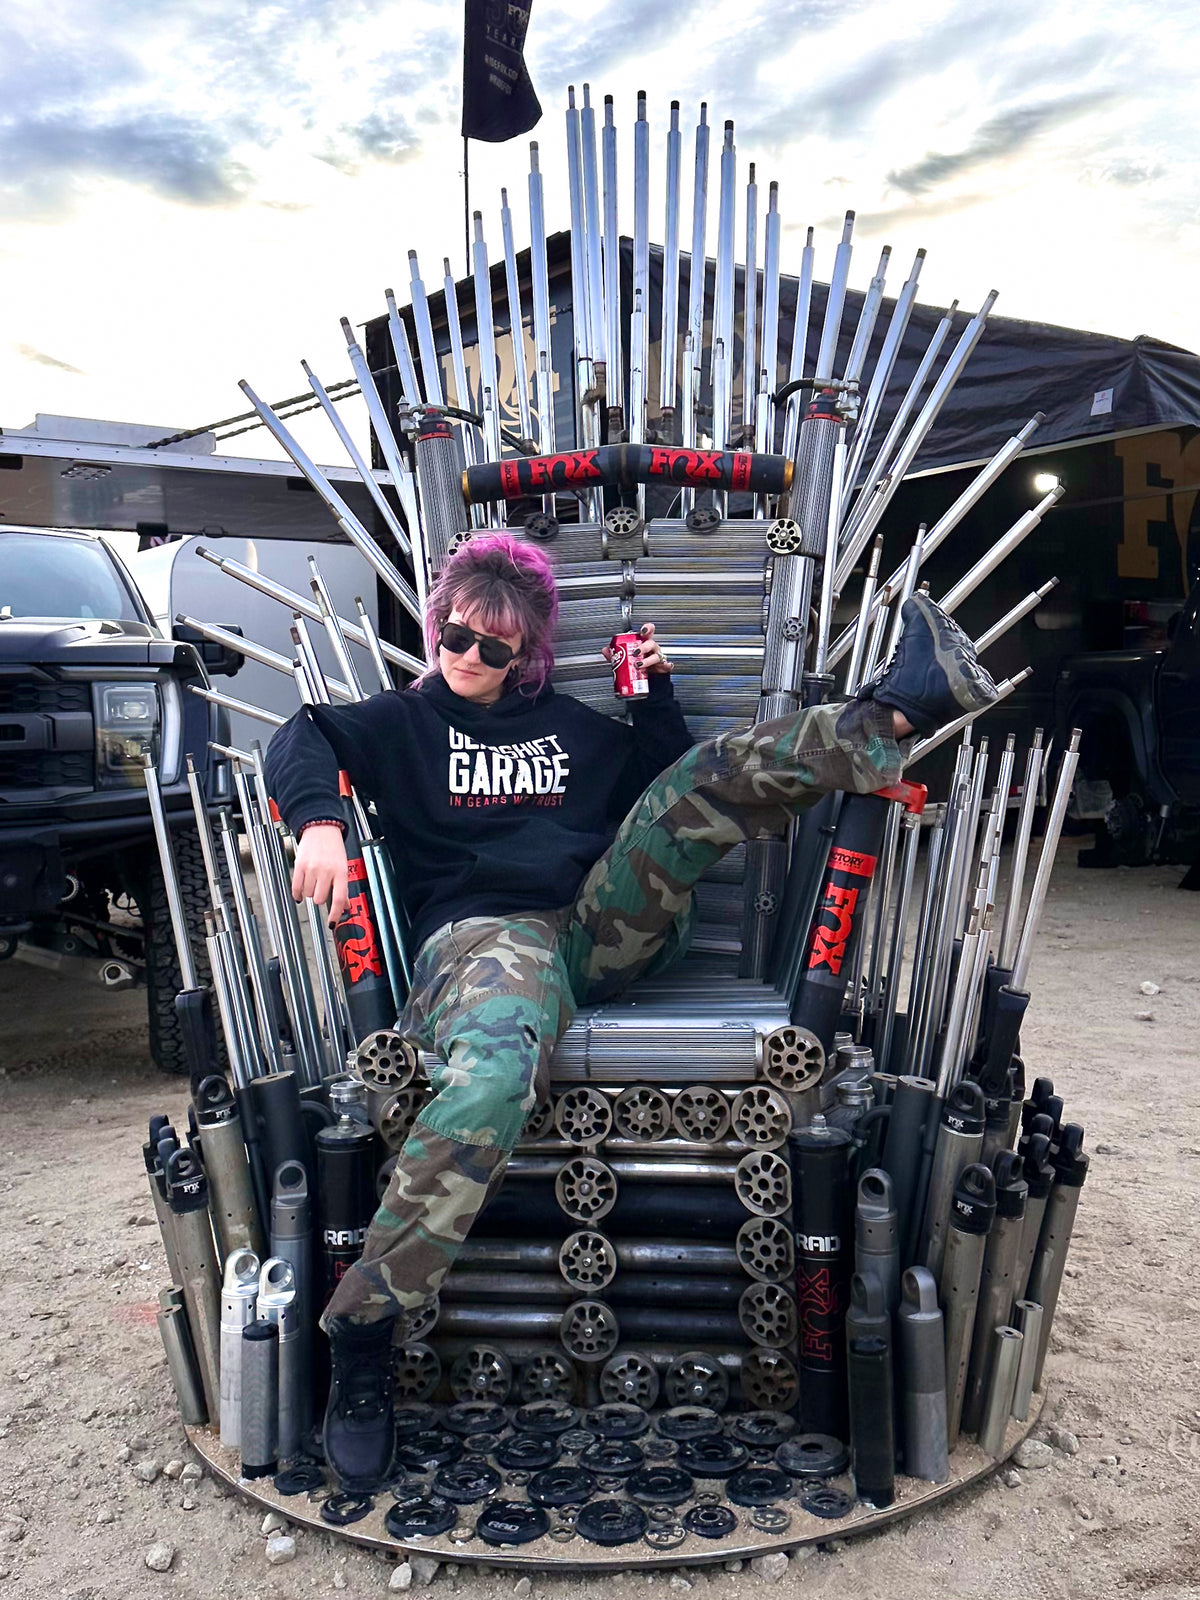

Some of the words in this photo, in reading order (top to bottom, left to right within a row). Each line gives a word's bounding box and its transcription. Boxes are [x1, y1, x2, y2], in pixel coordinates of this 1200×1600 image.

[528, 450, 601, 486] FOX
[649, 447, 723, 480] FOX
[449, 725, 563, 759] GESHIFT
[449, 751, 569, 795] GARAGE
[450, 795, 461, 807] IN
[467, 795, 507, 807] GEARS
[831, 852, 864, 867] CTORY
[335, 892, 383, 983] FOX
[808, 882, 859, 976] FOX
[947, 1115, 965, 1129] FOX
[183, 1181, 200, 1195] FOX
[956, 1200, 974, 1216] FOX
[797, 1266, 834, 1361] FOX
